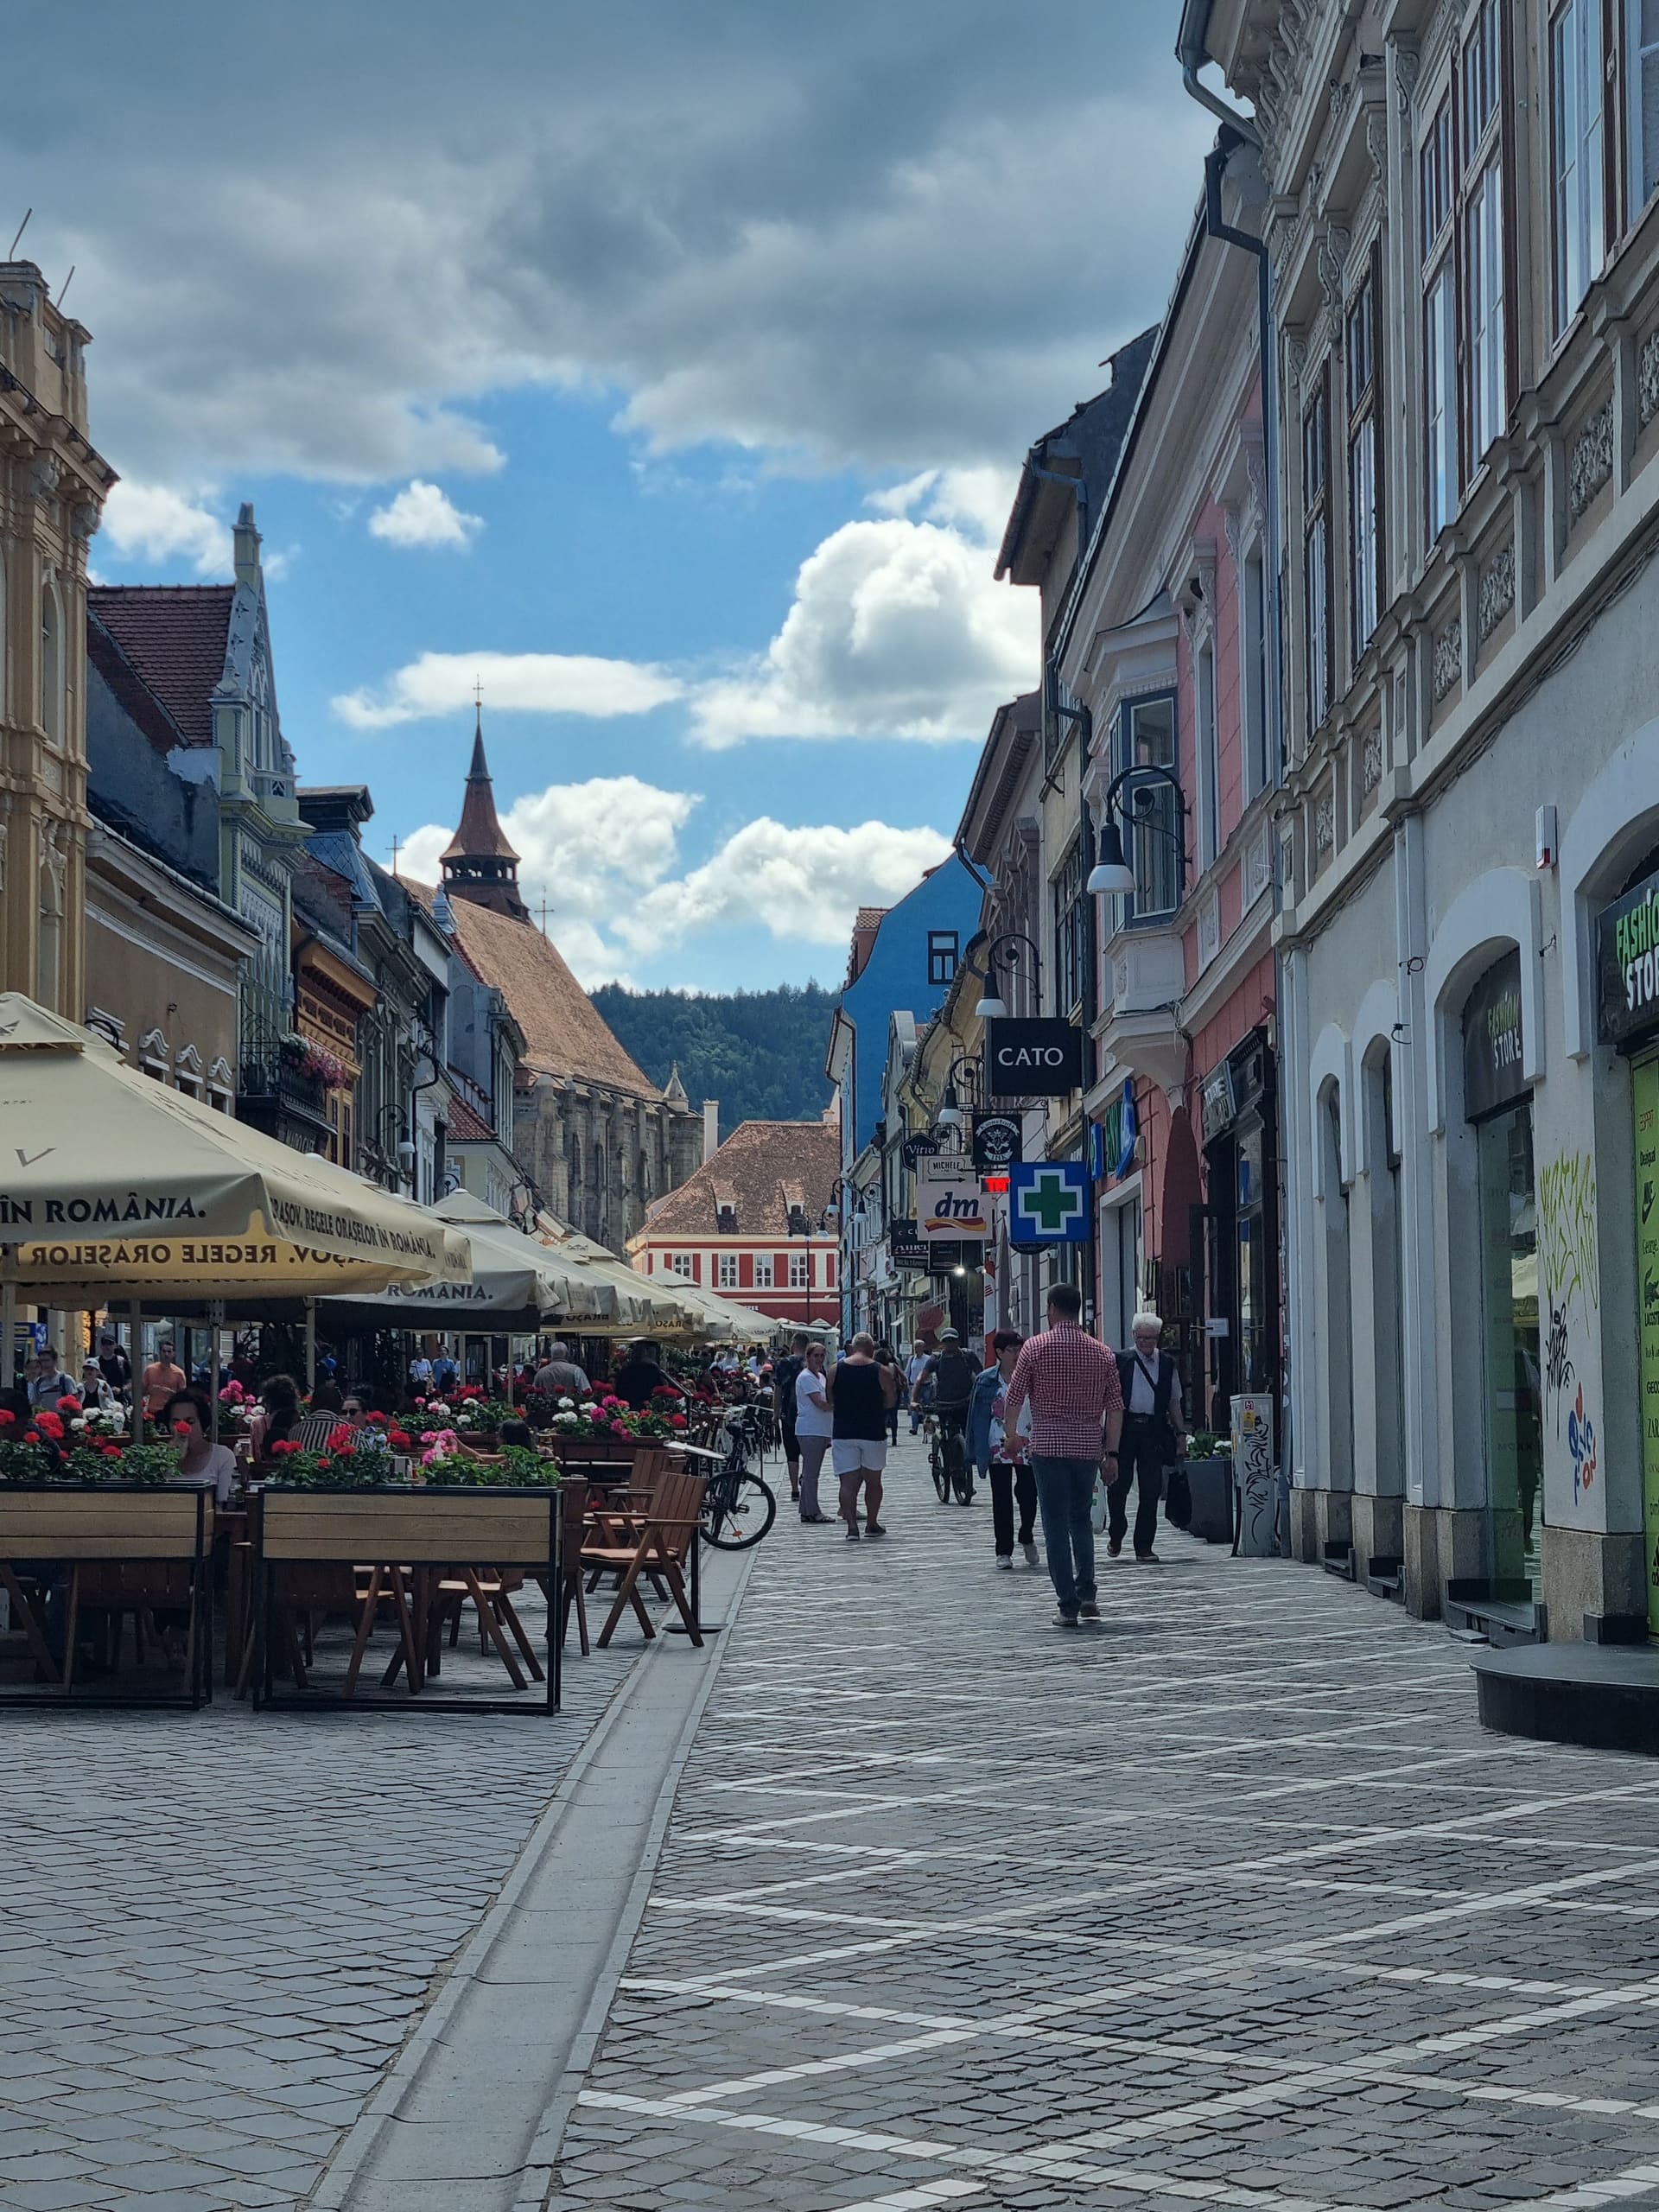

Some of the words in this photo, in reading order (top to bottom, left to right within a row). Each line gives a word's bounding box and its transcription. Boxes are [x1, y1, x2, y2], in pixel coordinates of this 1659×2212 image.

[998, 1047, 1064, 1066] CATO
[1494, 1027, 1522, 1071] STORE
[933, 1161, 961, 1170] MICHELE
[0, 1195, 32, 1224] ÎN
[46, 1192, 207, 1223] ROMÂNIA.
[935, 1192, 979, 1217] dm
[304, 1208, 334, 1236] REGELE
[389, 1231, 436, 1259] ROMÂNIA.
